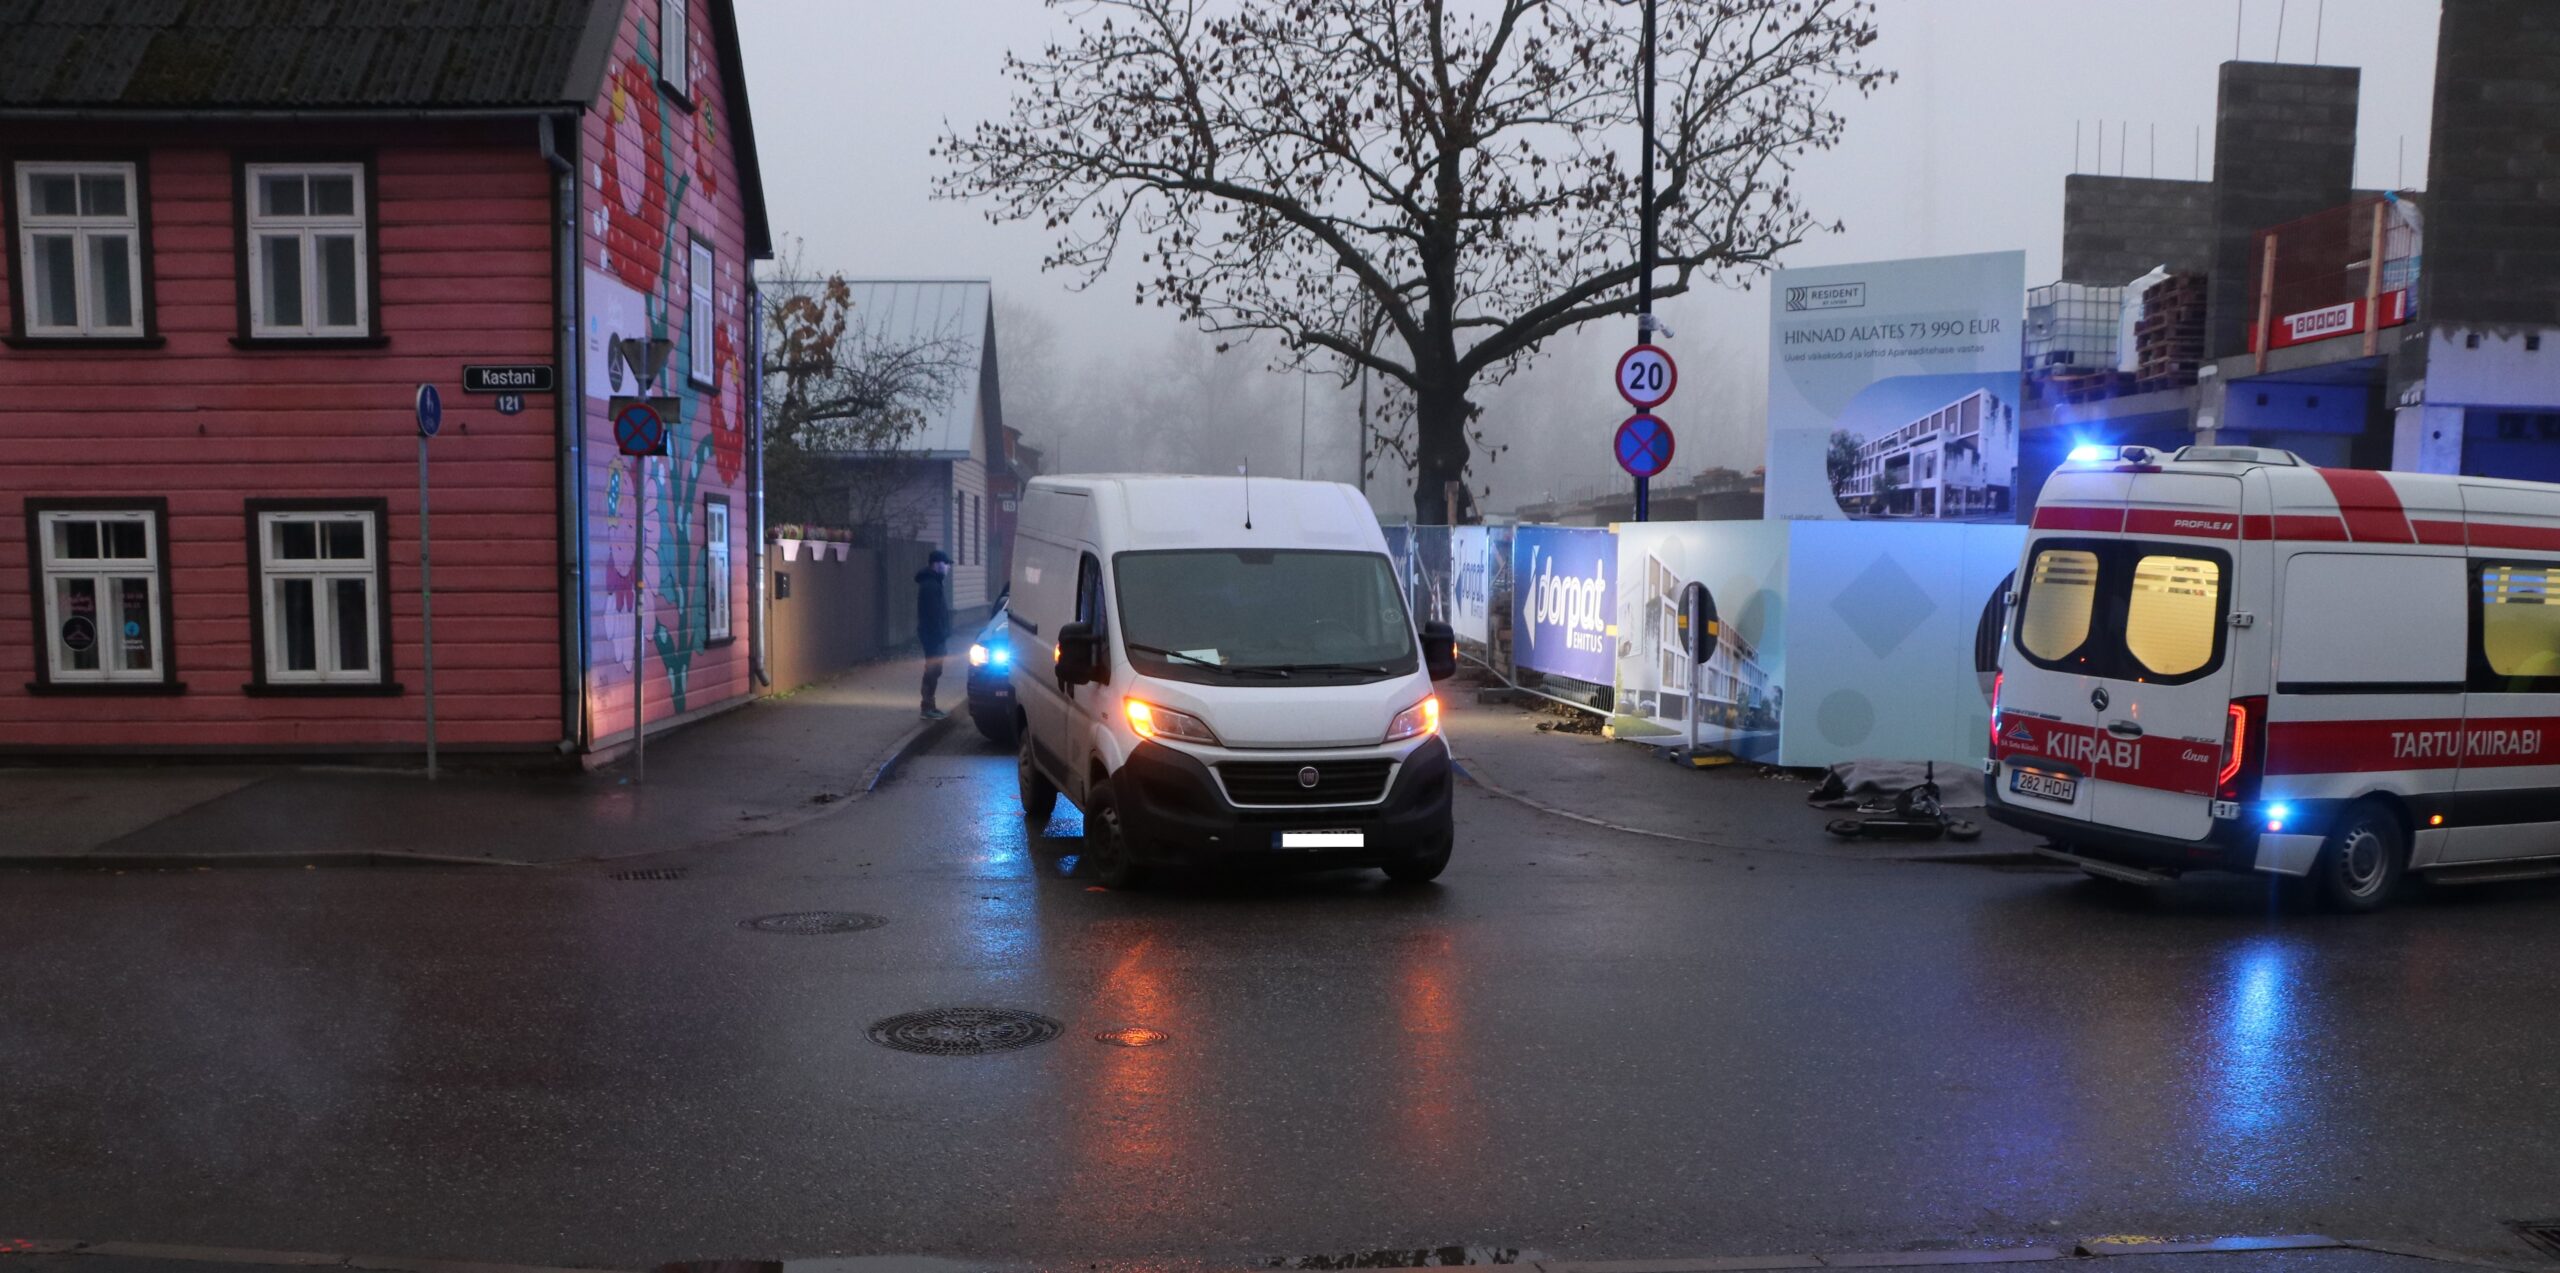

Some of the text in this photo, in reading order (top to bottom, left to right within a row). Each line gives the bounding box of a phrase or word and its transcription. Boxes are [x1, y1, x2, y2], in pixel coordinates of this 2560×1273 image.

[1812, 288, 1859, 299] RESIDENT
[1785, 319, 2000, 344] HINNAD ALATES 73 990 EUR
[1785, 353, 1806, 362] Uued
[1854, 350, 1862, 360] ja
[482, 369, 536, 385] Kastani
[1630, 362, 1663, 391] 20
[499, 396, 519, 411] 121
[2174, 519, 2222, 530] PROFILE
[1537, 555, 1606, 648] dorpat
[1573, 631, 1603, 653] EHITUS
[2046, 731, 2141, 769] KIIRABI
[2392, 729, 2541, 758] TARTU KIIRABI
[2181, 748, 2209, 763] Anne
[2020, 774, 2040, 792] 282
[2043, 778, 2071, 797] HDH
